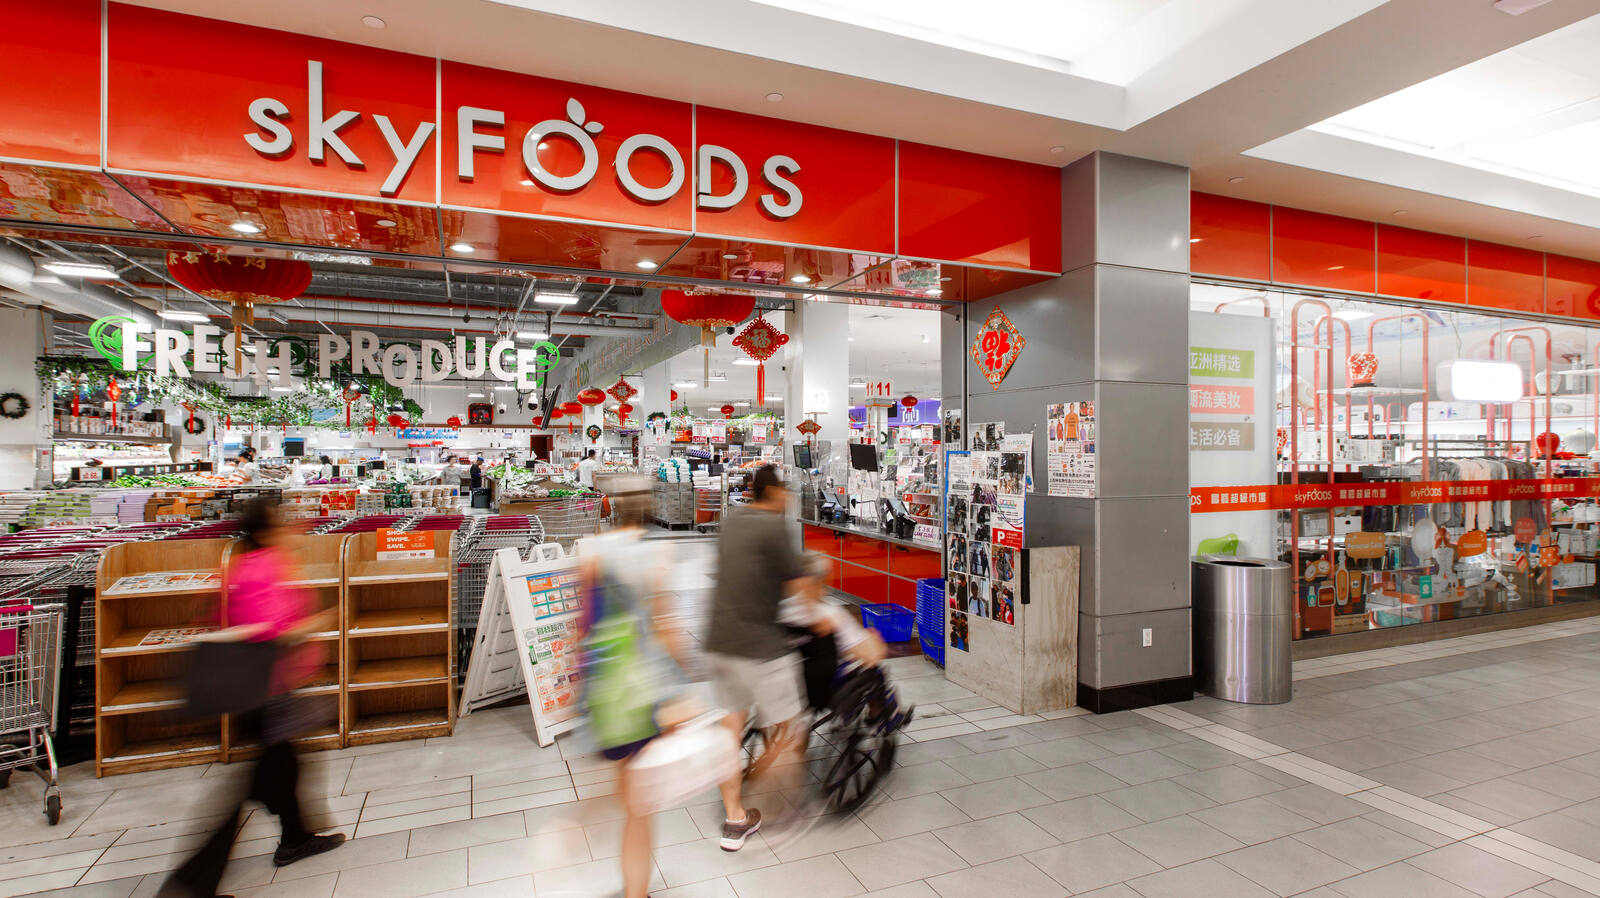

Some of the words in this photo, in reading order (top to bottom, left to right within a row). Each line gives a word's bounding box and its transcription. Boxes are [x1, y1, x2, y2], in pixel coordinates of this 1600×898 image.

[243, 59, 803, 219] skyFOODS
[122, 322, 291, 386] FRESH
[318, 330, 537, 390] PRODUCE
[877, 382, 890, 396] 11
